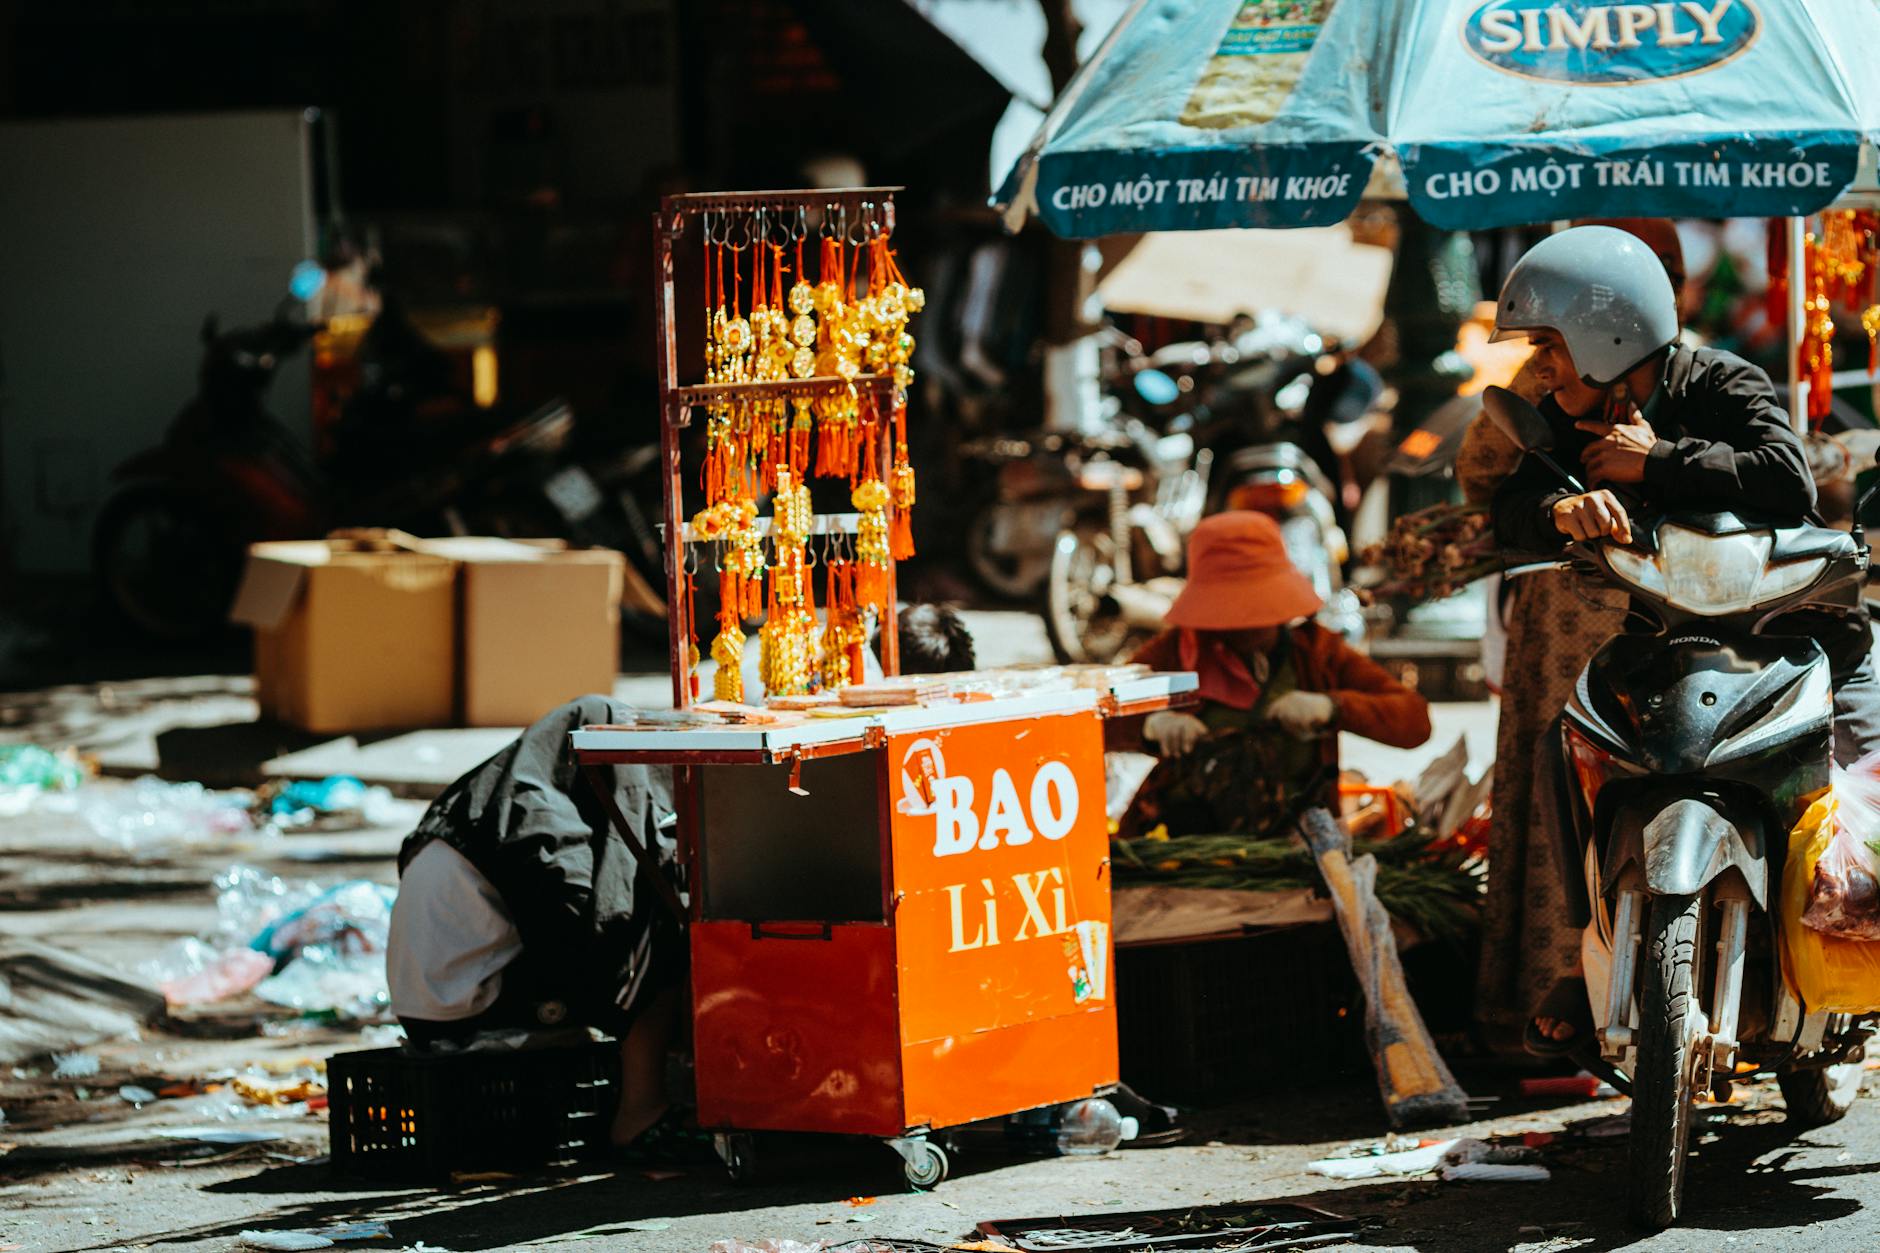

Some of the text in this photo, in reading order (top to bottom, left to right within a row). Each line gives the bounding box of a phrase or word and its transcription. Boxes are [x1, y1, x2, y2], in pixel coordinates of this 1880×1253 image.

[1480, 0, 1732, 52] SIMPLY
[1052, 164, 1351, 211] CHO MỘT TRÁI TIM KHỎE
[1425, 146, 1832, 199] CHO MỘT TRÁI TIM KHỎE
[1669, 636, 1720, 646] HONDA
[933, 761, 1079, 857] BAO
[944, 867, 1073, 953] Lì Xì
